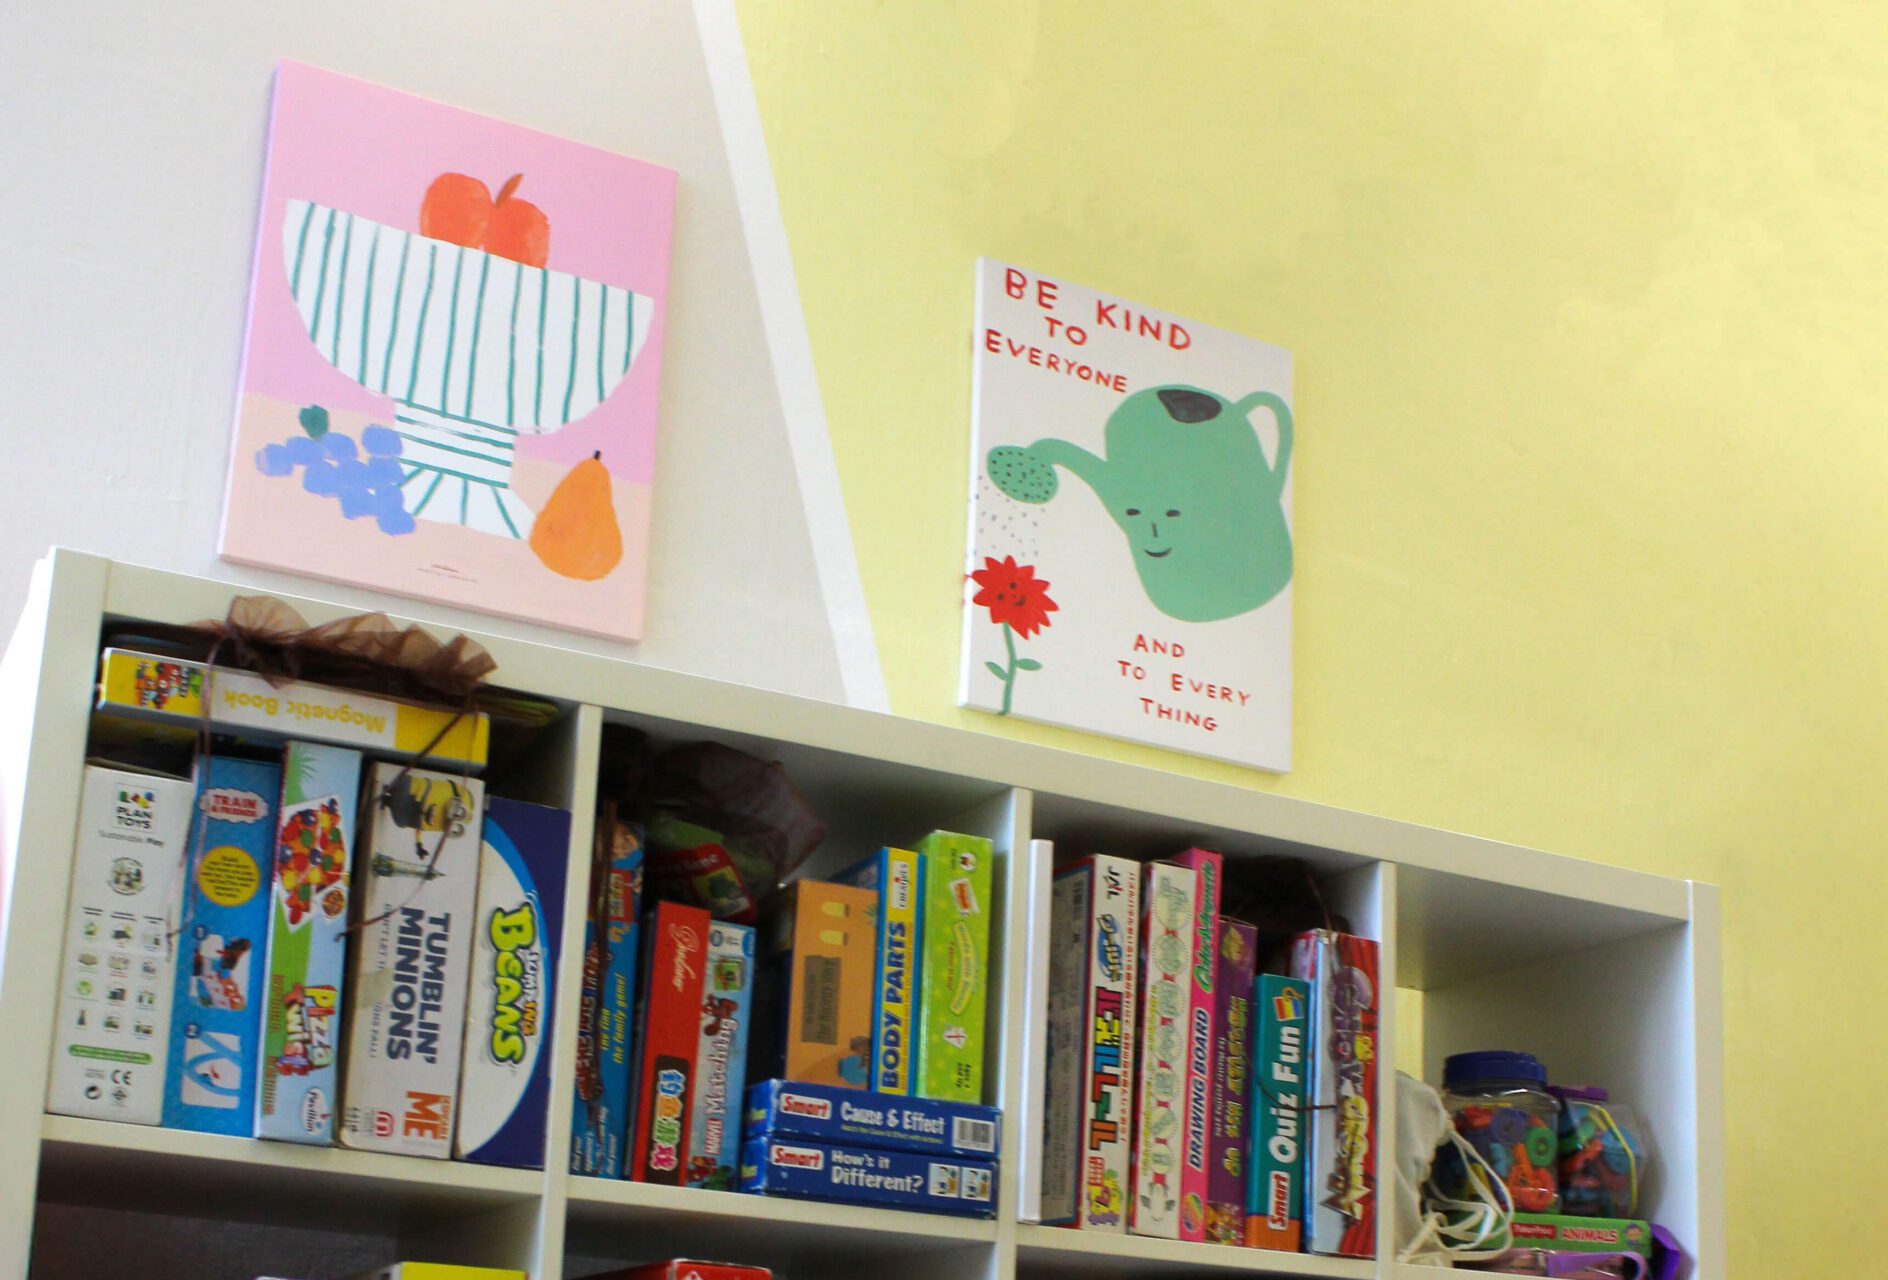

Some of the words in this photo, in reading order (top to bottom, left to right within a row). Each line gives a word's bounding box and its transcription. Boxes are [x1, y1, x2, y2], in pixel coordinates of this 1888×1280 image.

[1005, 268, 1060, 310] BE
[1096, 300, 1192, 351] KIND
[1044, 317, 1088, 347] TO
[986, 328, 1129, 394] EVERYONE
[1133, 633, 1185, 659] AND
[223, 687, 280, 717] Book
[1118, 660, 1146, 681] TO
[1171, 672, 1251, 707] EVERY
[286, 700, 387, 735] Magnetic
[1140, 697, 1220, 732] THING
[116, 815, 152, 830] TOYS
[117, 806, 153, 819] PLAN
[386, 906, 425, 1060] MINIONS
[416, 911, 451, 1064] TUMBLIN'
[489, 901, 537, 1066] BEANS
[884, 922, 907, 1004] PARTS
[303, 985, 338, 1067] Pizza
[882, 1009, 902, 1089] BODY
[1191, 1008, 1210, 1075] BOARD
[704, 1017, 739, 1116] Matching
[1272, 1025, 1301, 1083] Fun
[404, 1090, 443, 1140] ME
[704, 1118, 723, 1155] MARVEL
[783, 1094, 829, 1119] Smart
[840, 1100, 885, 1127] Cause
[886, 1110, 899, 1128] &
[902, 1109, 946, 1135] Effect
[1188, 1077, 1208, 1172] DRAWING
[1267, 1092, 1299, 1163] Quiz
[774, 1147, 821, 1168] Smart
[831, 1149, 875, 1168] How's
[878, 1155, 891, 1169] it
[831, 1166, 925, 1194] Different?
[1269, 1174, 1289, 1229] Smart
[1562, 1227, 1618, 1243] ANIMALS
